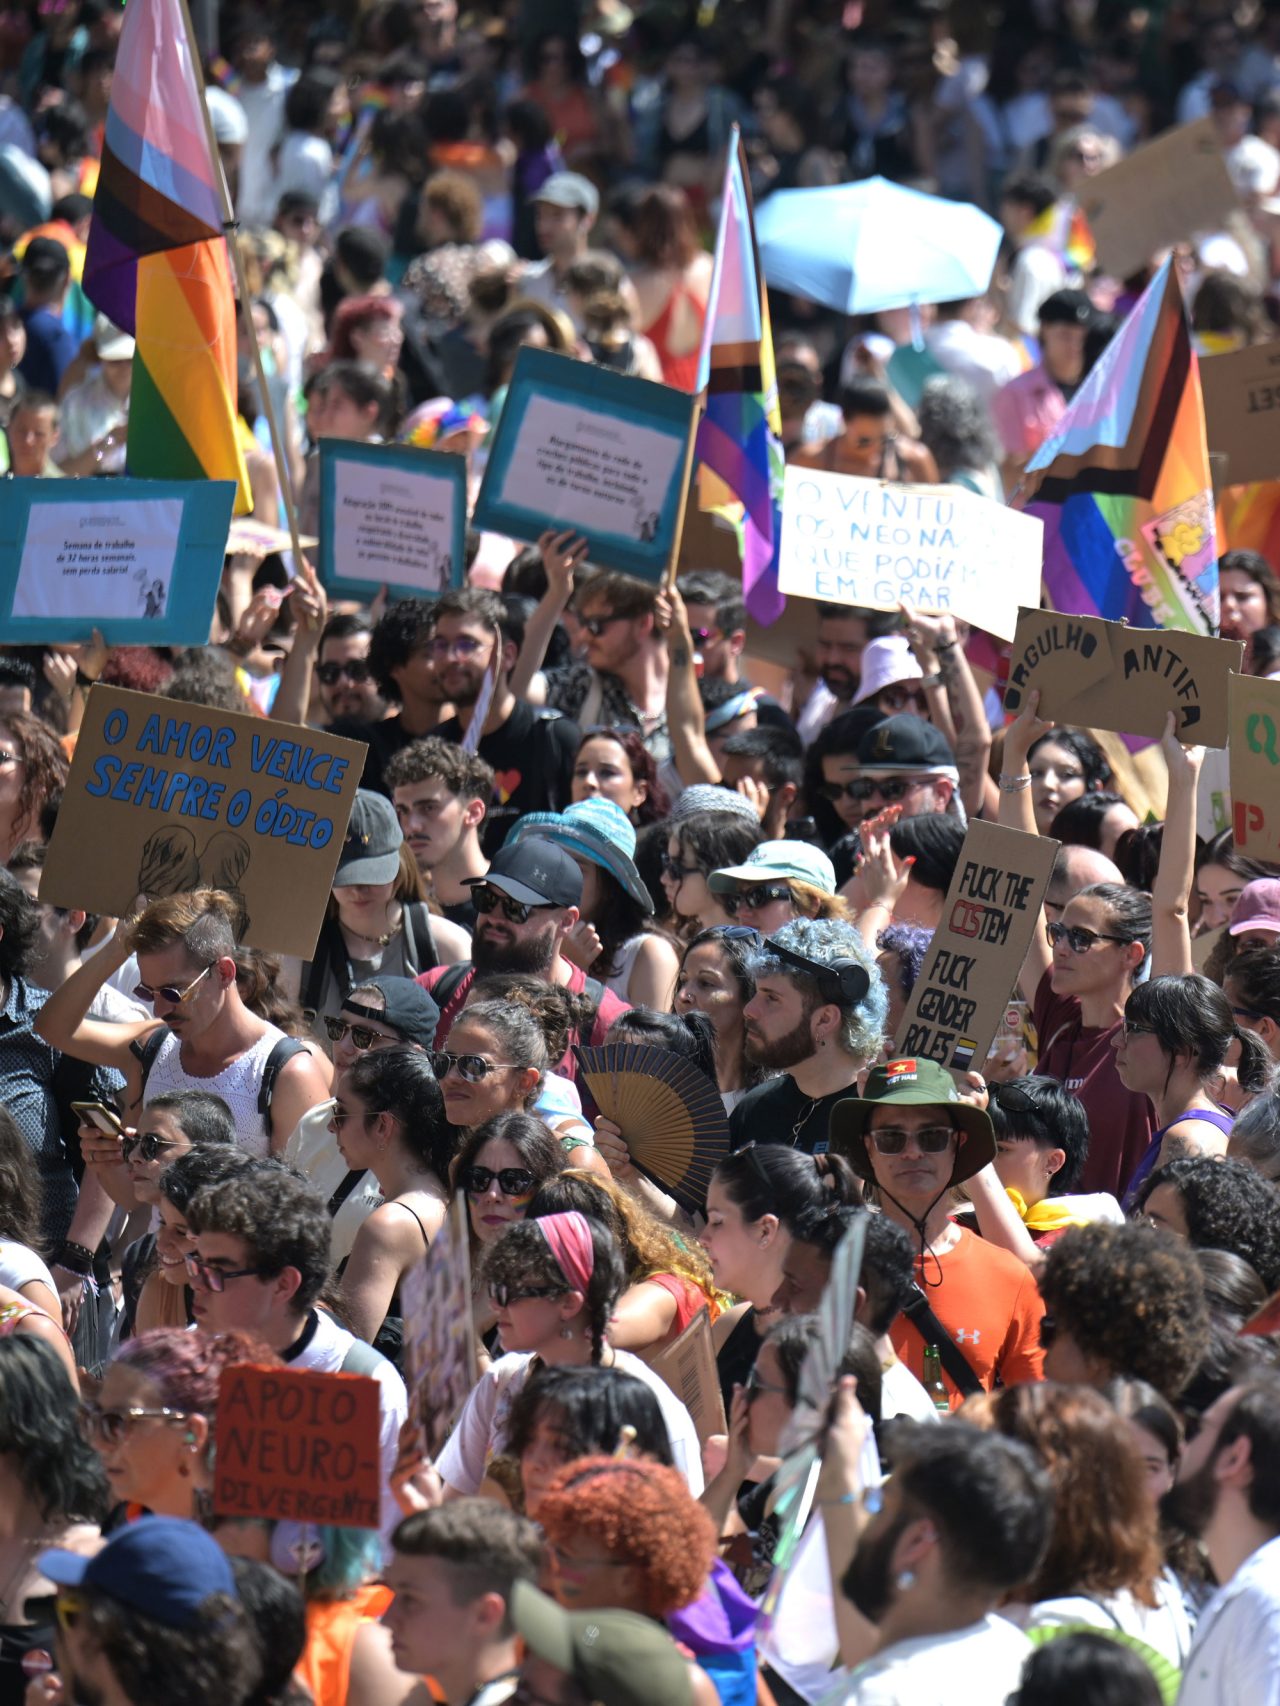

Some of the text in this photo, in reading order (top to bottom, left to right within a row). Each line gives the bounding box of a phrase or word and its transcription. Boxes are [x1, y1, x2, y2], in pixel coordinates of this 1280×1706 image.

[56, 554, 65, 563] de
[67, 553, 77, 563] 32
[78, 554, 99, 563] horas
[64, 539, 135, 551] Semana de trabalho
[62, 565, 128, 577] sem perda salarial
[1004, 622, 1200, 729] ORGULHO ANTIFA
[103, 708, 350, 794] O AMOR VENCE
[85, 754, 334, 850] SEMPRE O ÓDIO
[958, 860, 1036, 911] FUCK THE
[948, 899, 1014, 947] CISTEM
[927, 949, 977, 992] FUCK
[915, 986, 977, 1034] GENDER
[900, 1023, 955, 1067] ROLES
[901, 1074, 918, 1082] NAM
[223, 1377, 357, 1426] APOIO
[220, 1426, 376, 1483] NEURO-
